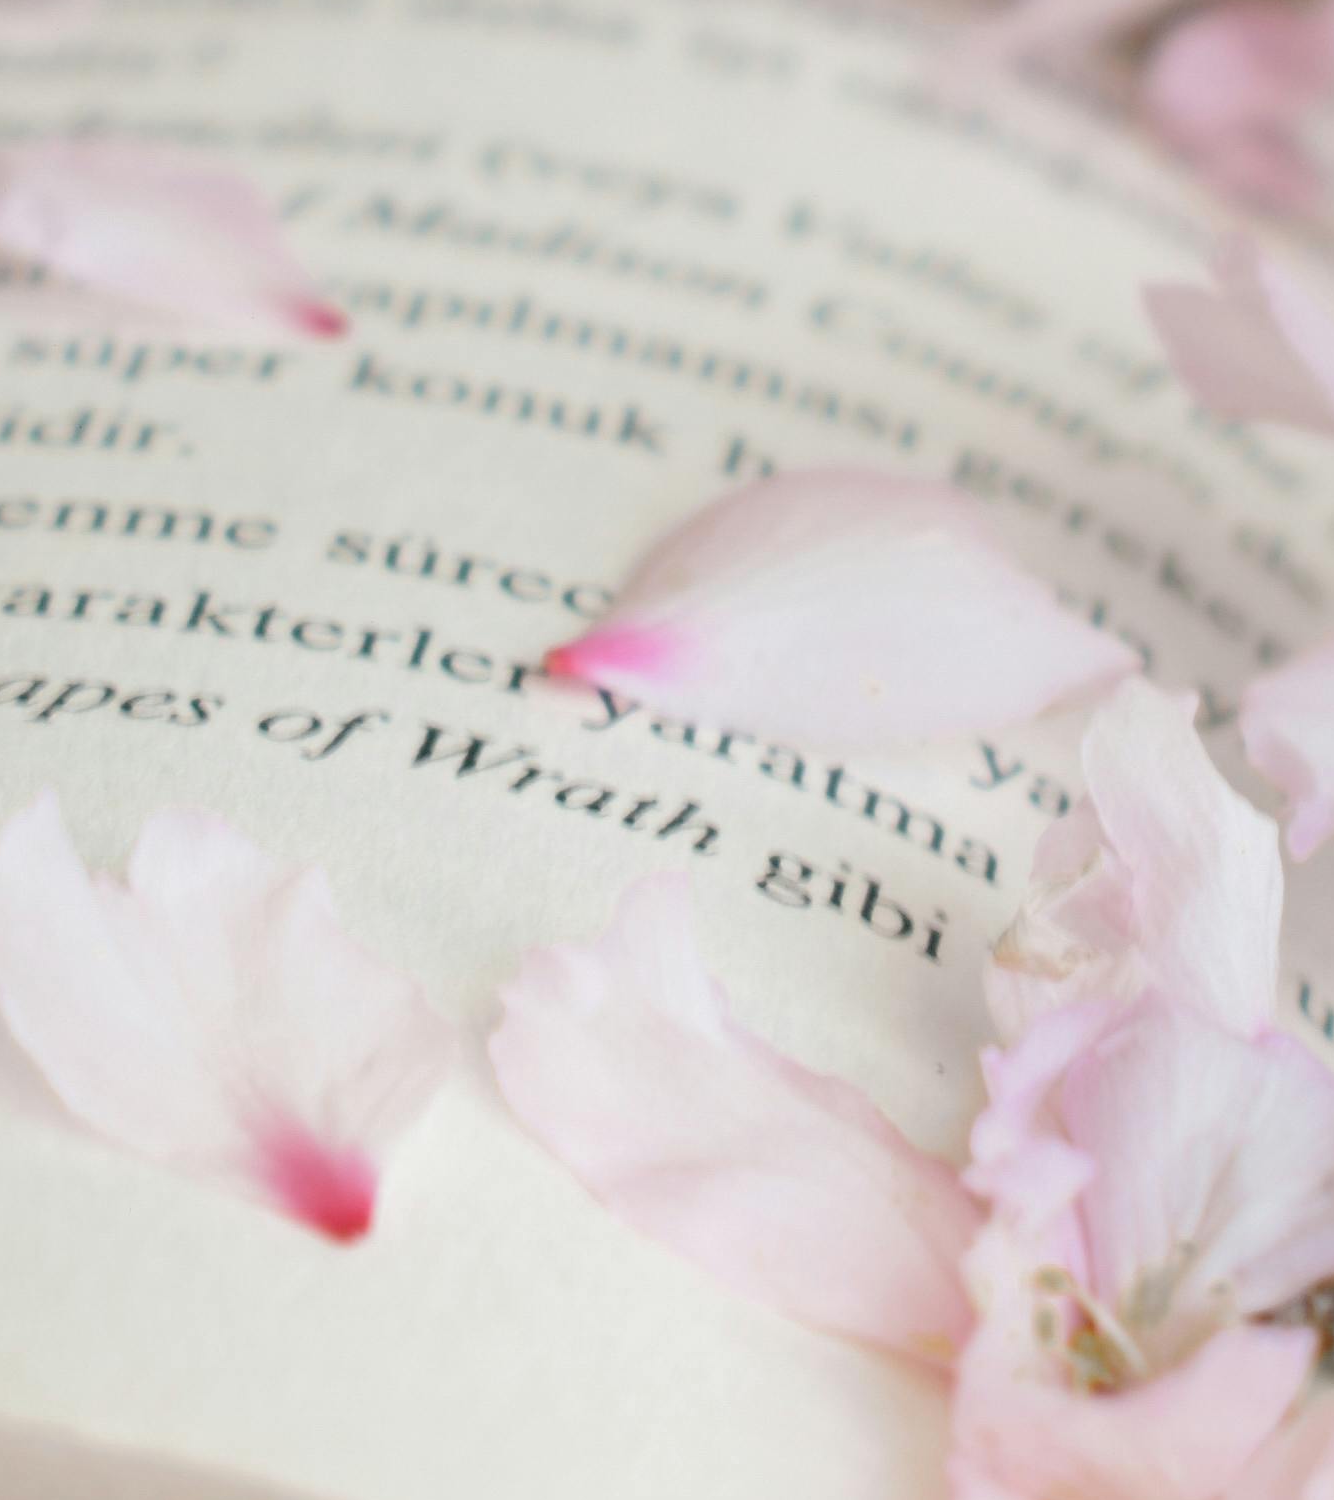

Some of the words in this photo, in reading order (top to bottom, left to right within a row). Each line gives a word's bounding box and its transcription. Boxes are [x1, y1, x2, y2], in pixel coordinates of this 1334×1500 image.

[7, 325, 295, 385] süper
[347, 355, 665, 455] konuk
[255, 700, 395, 765] of
[409, 722, 722, 862] Wrath
[755, 845, 952, 968] gibi
